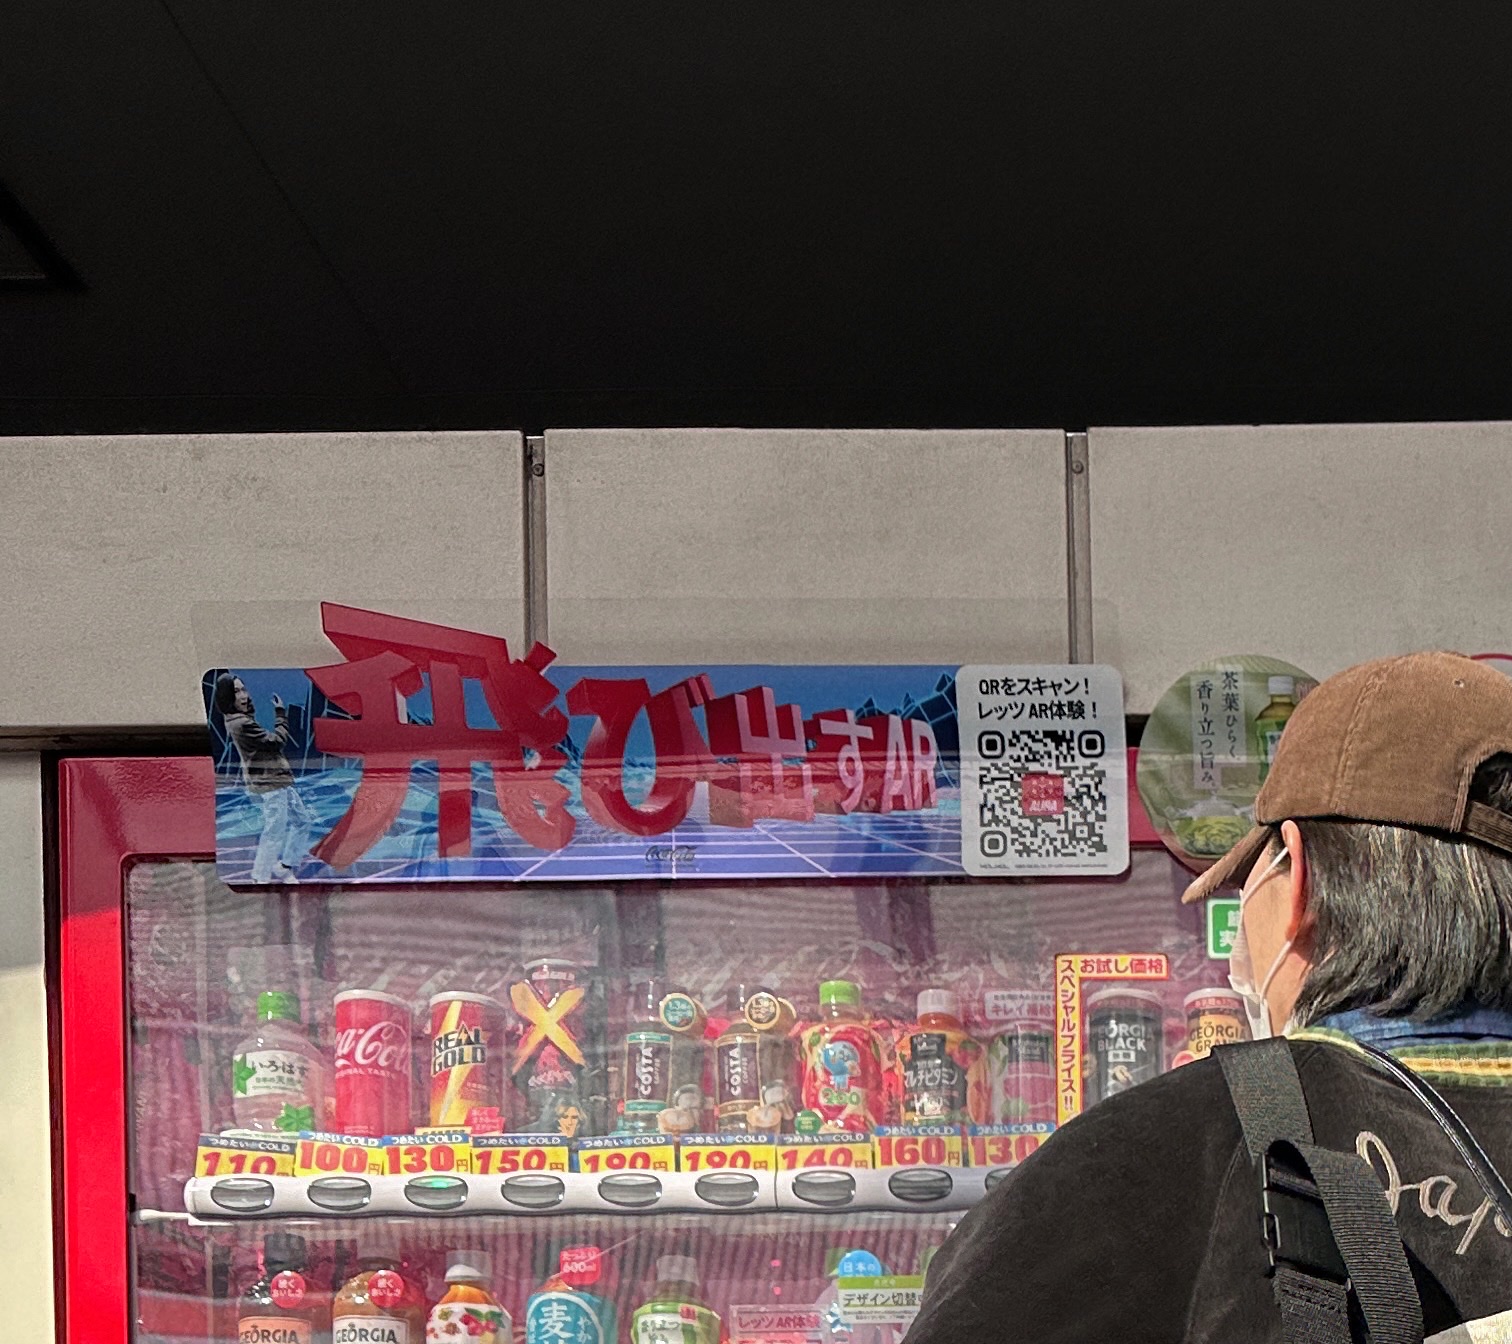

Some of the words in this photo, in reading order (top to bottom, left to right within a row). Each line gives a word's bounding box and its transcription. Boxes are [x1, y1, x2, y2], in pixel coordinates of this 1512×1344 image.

[1080, 958, 1165, 974] お試し価格
[433, 1022, 484, 1056] REAL
[432, 1046, 487, 1076] GOLD
[1011, 1122, 1047, 1133] COLD
[426, 1134, 463, 1144] COLD
